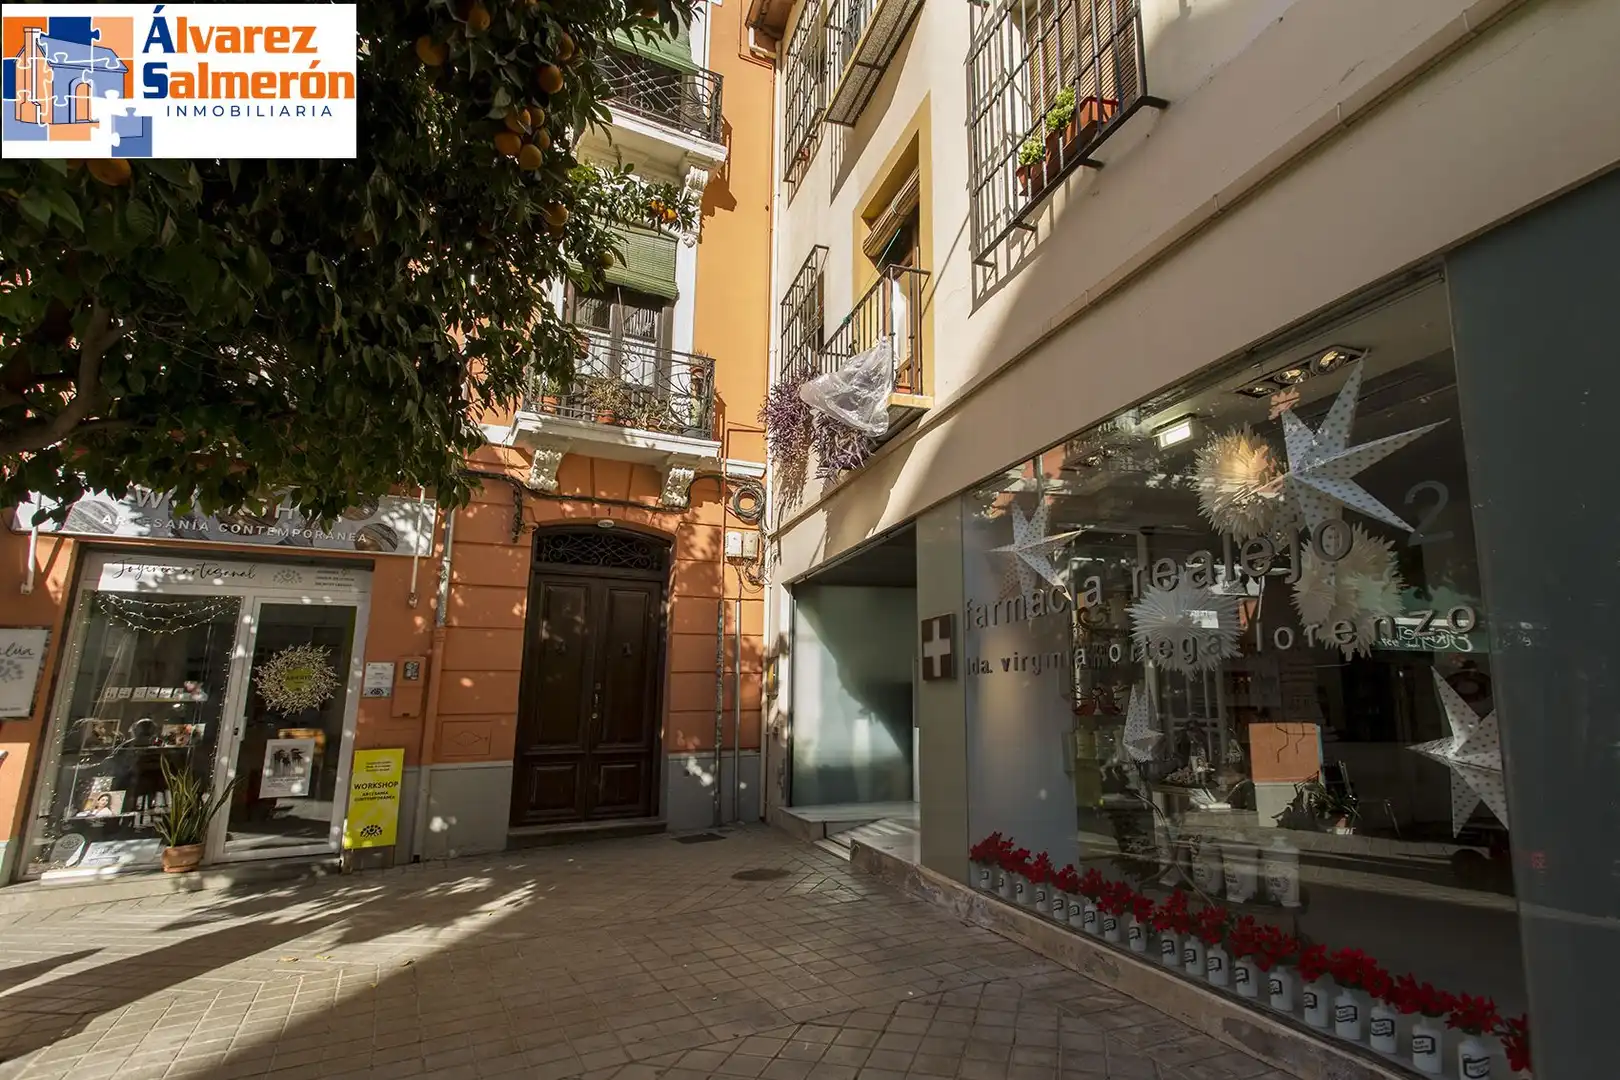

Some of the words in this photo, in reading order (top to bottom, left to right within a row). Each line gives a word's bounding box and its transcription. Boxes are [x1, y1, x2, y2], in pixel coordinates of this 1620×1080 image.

[1404, 480, 1454, 547] 2
[965, 575, 1104, 632] farmacia
[1132, 516, 1353, 598] realejo
[1256, 605, 1476, 652] lorenzo
[354, 781, 398, 790] WORKSHOP
